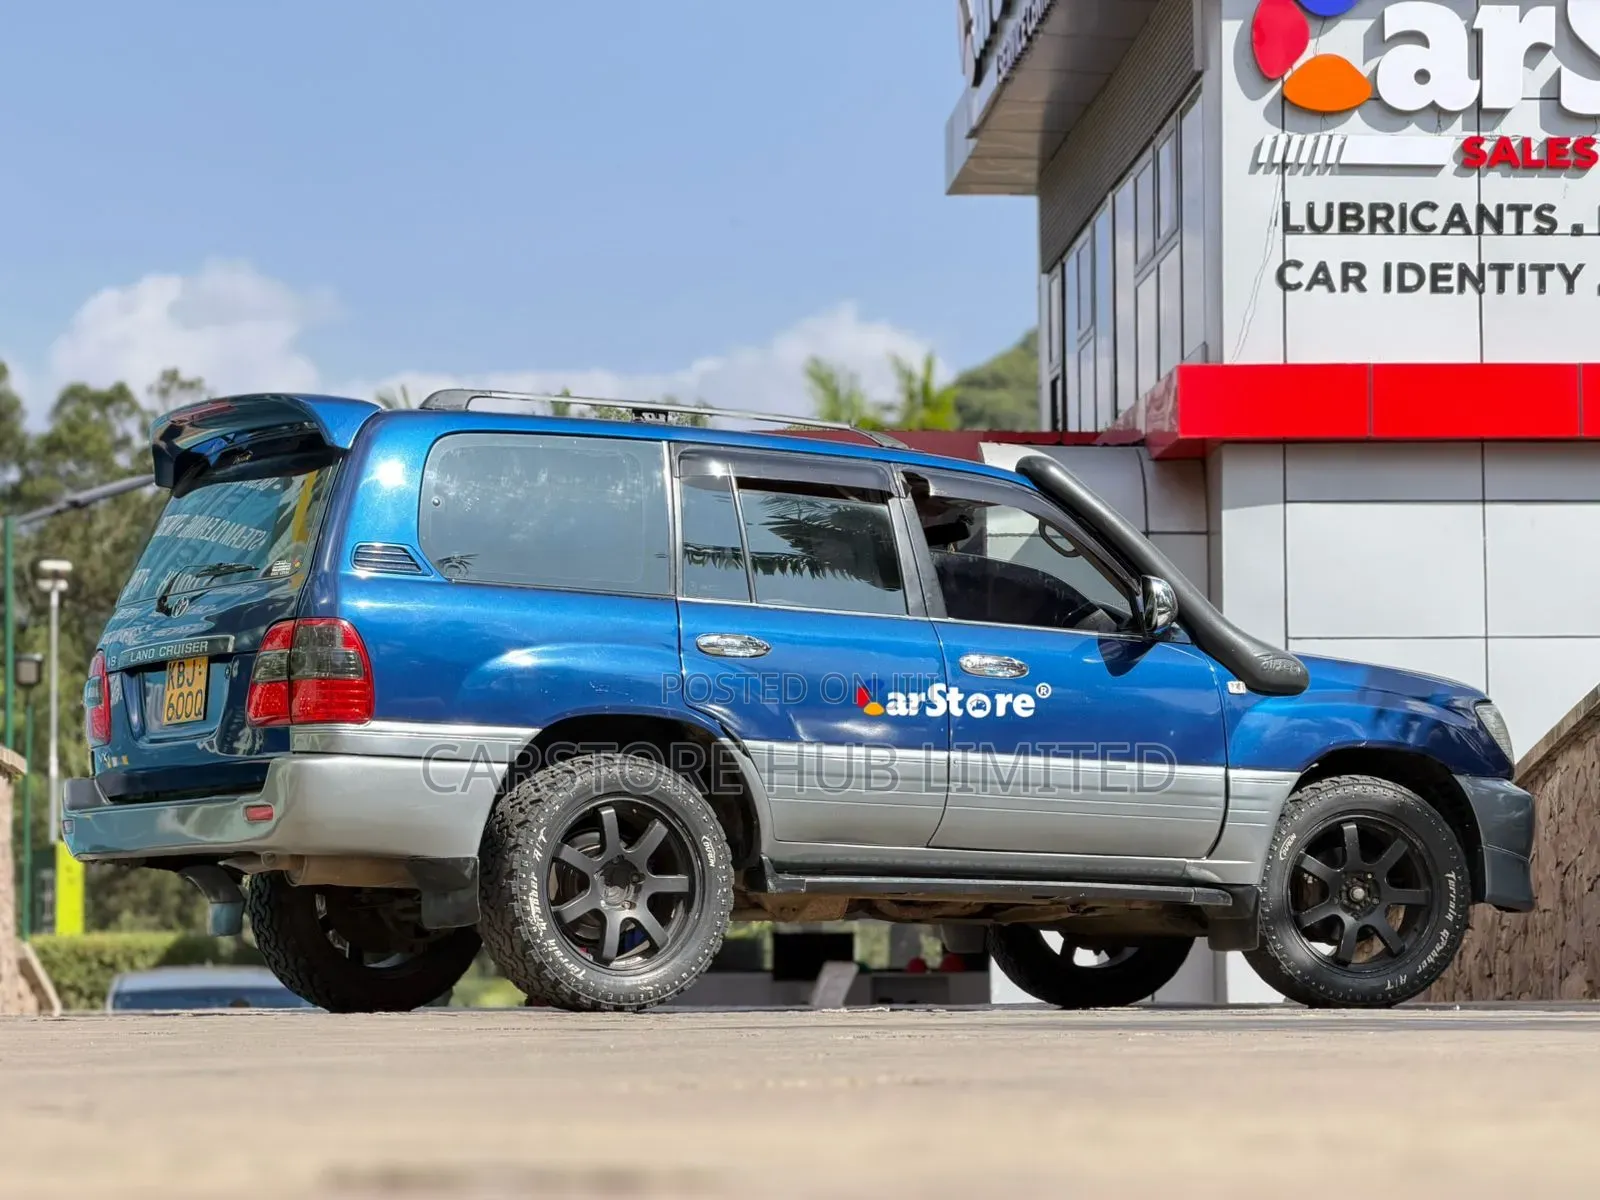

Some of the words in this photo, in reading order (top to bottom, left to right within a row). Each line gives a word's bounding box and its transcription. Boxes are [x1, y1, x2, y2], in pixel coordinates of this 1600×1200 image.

[1462, 136, 1599, 169] SALES
[1276, 259, 1367, 293] CAR
[1383, 261, 1586, 295] IDENTITY
[130, 649, 155, 662] LAND
[159, 640, 209, 657] CRUISER
[167, 659, 196, 691] KBJ
